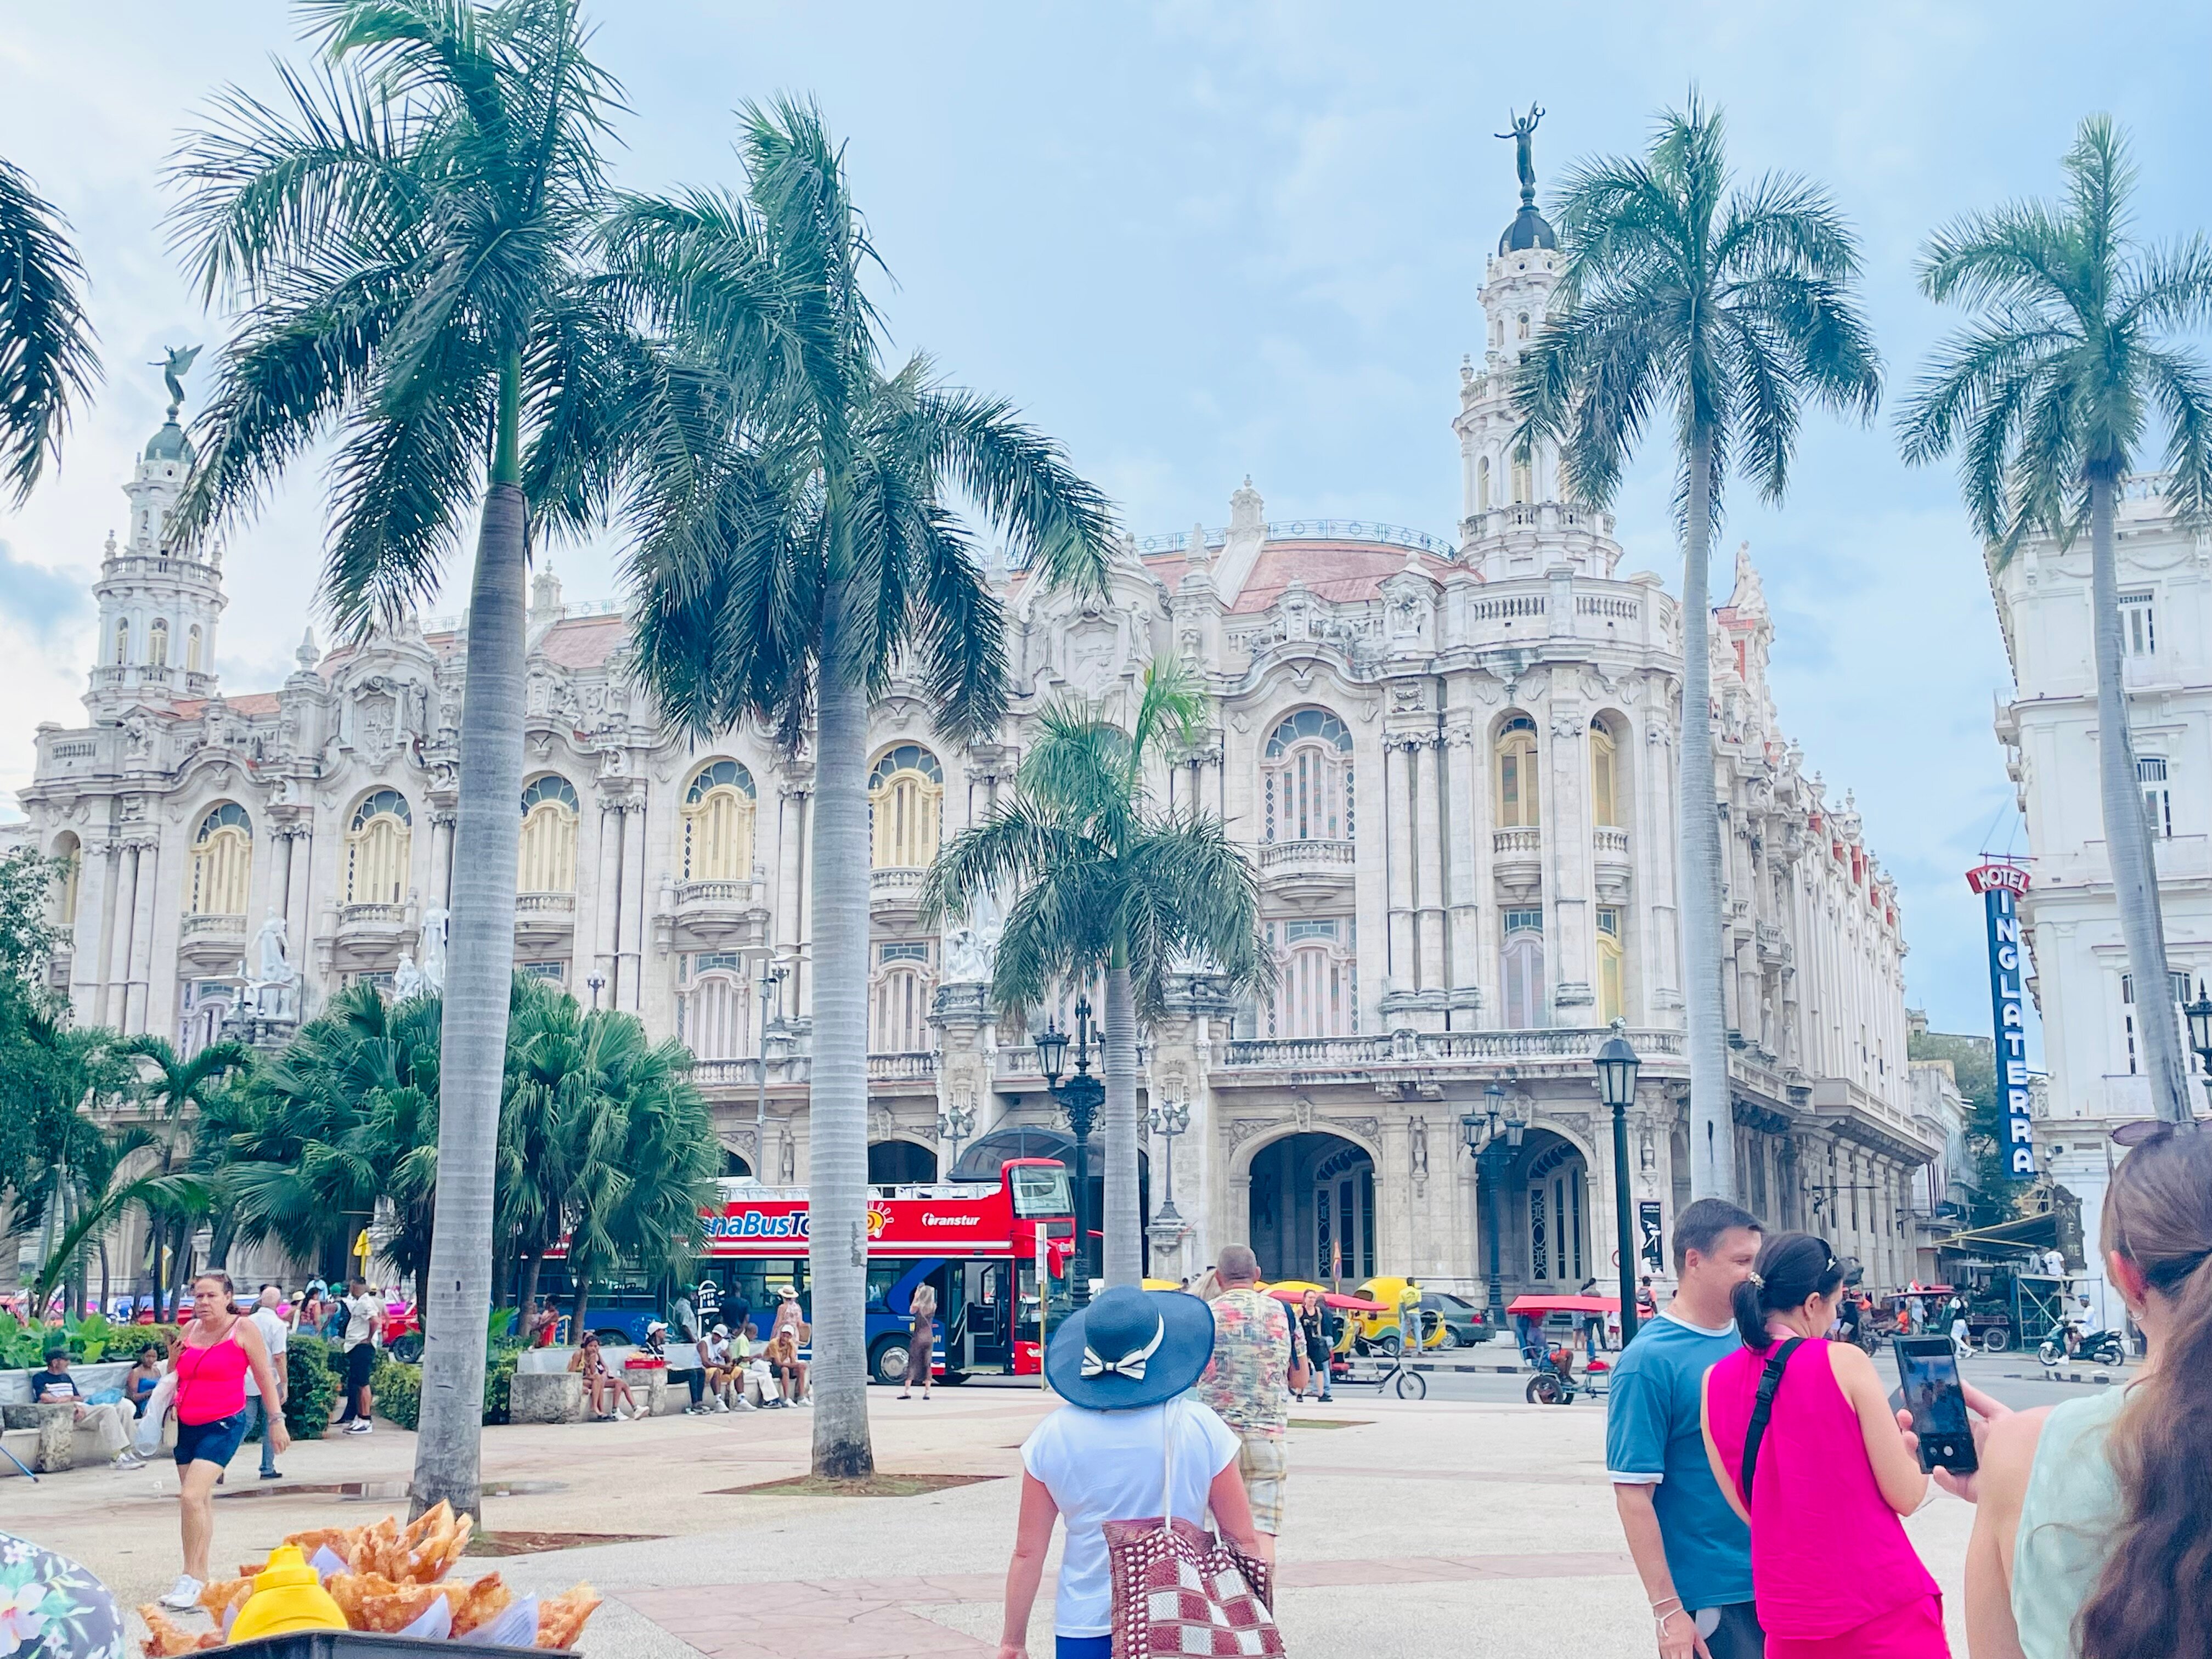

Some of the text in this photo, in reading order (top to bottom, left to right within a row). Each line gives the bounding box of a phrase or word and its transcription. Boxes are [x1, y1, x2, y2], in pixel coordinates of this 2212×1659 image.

[1976, 867, 2028, 893] HOTEL
[1995, 889, 2034, 1173] INGLATERRA
[703, 1210, 810, 1238] naBusTo
